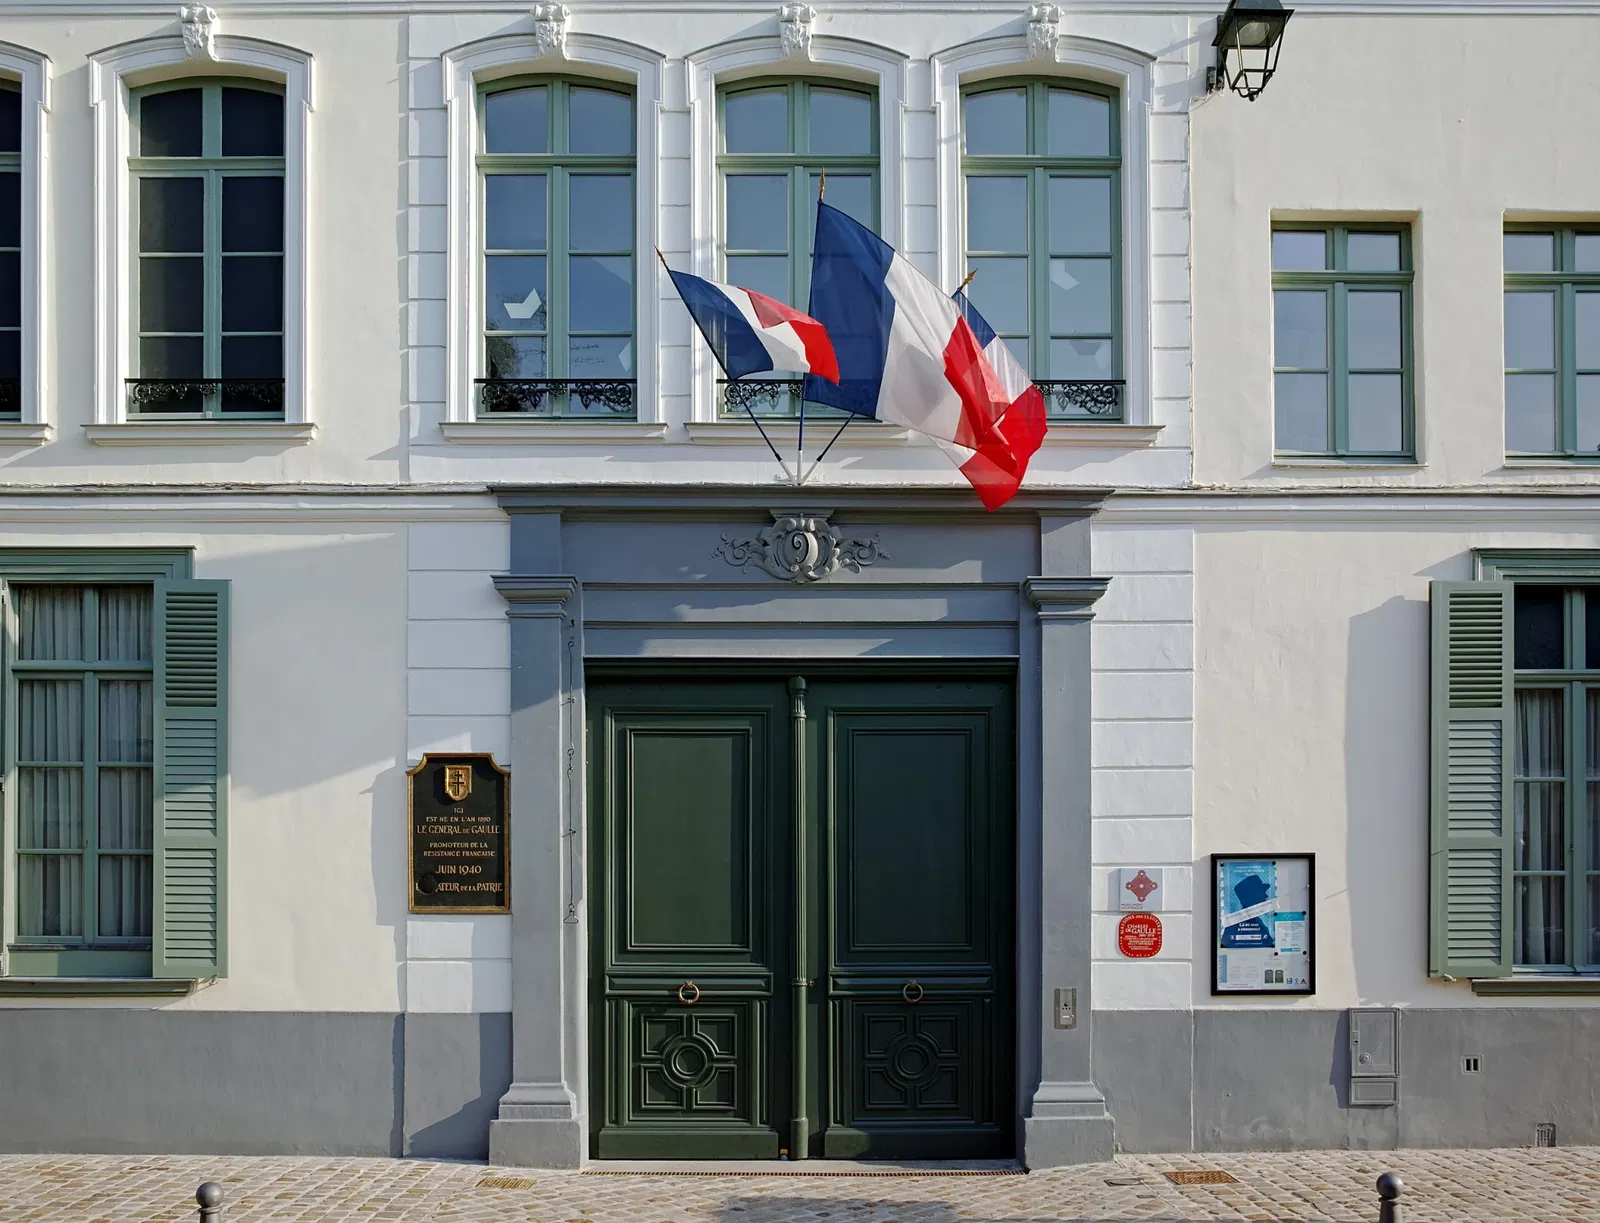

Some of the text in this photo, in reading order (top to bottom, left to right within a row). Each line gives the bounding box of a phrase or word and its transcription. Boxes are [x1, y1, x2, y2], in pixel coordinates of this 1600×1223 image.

[417, 825, 427, 834] LE
[428, 825, 462, 835] GENERAL
[471, 825, 500, 834] GAULLE
[436, 865, 482, 875] JUIN 1940
[477, 883, 503, 893] PATRIE
